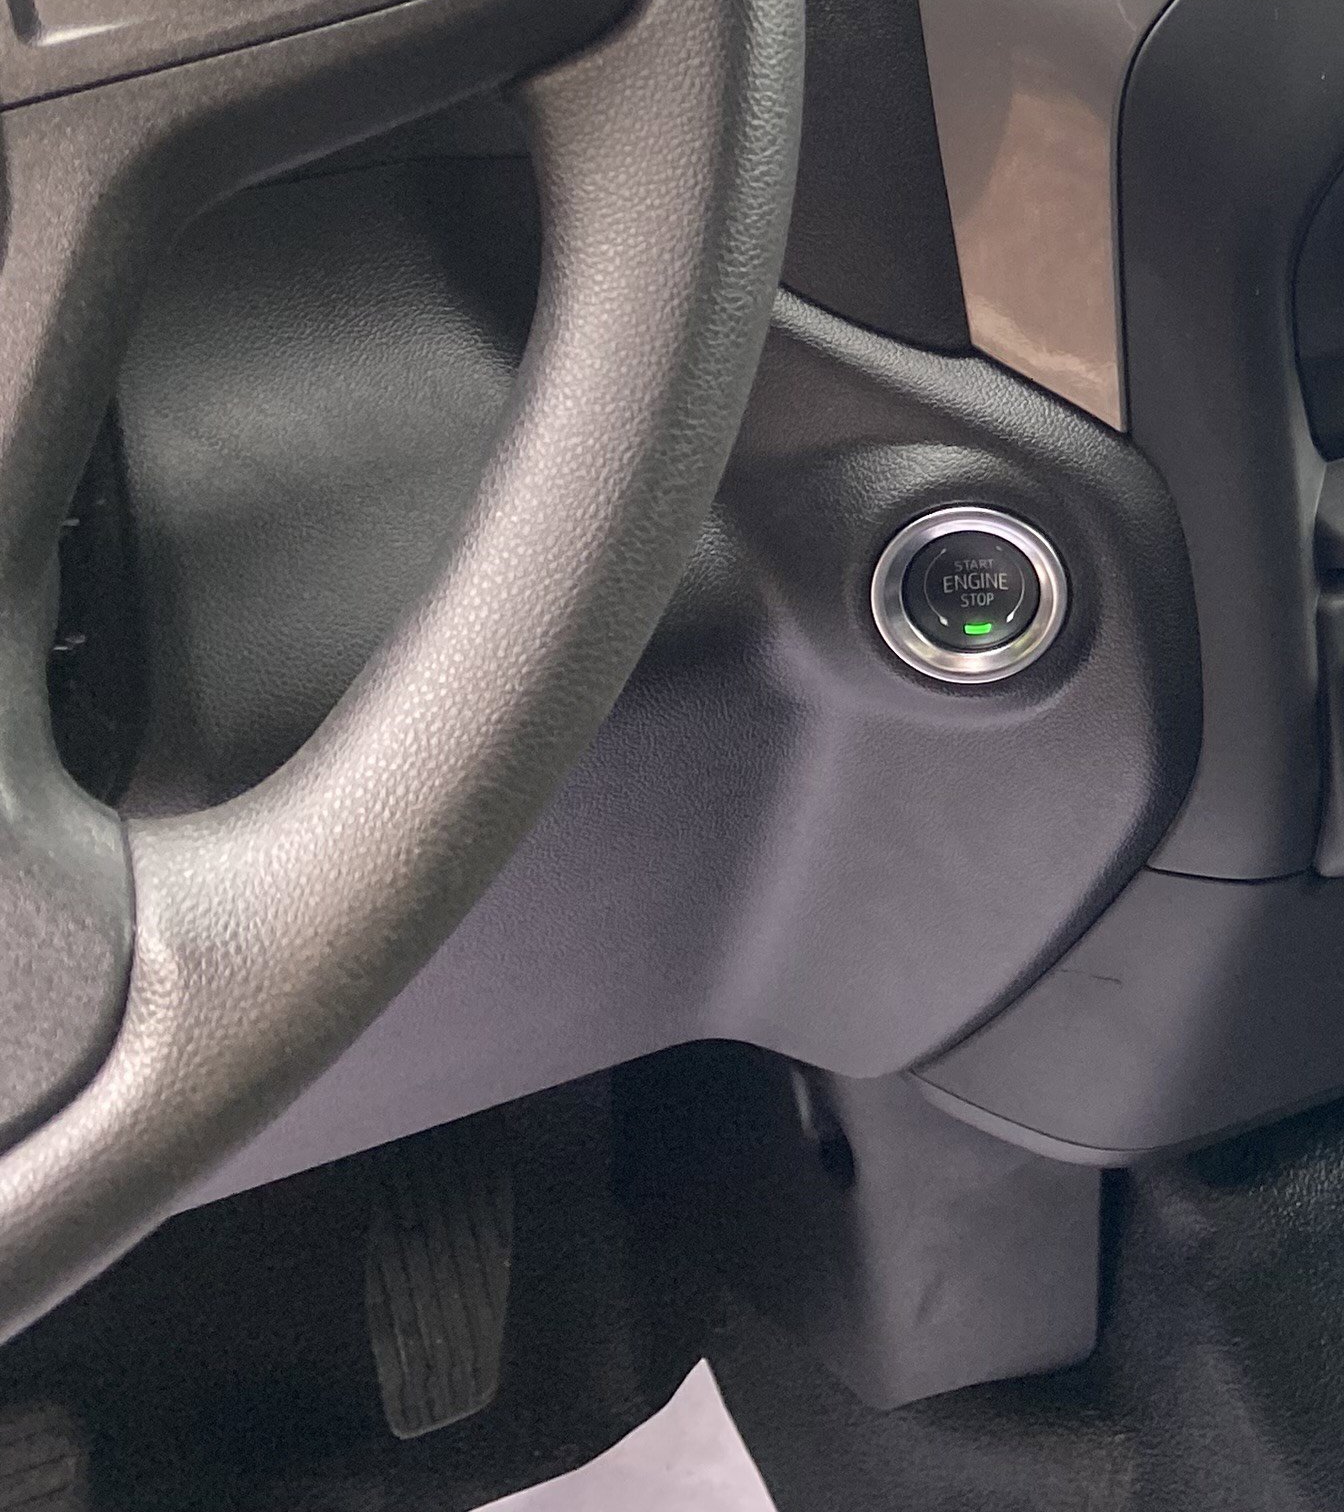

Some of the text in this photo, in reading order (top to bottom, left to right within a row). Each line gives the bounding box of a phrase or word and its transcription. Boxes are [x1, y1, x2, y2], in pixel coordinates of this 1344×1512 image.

[955, 559, 994, 571] START
[943, 573, 1008, 593] ENGINE
[961, 593, 994, 607] STOP
